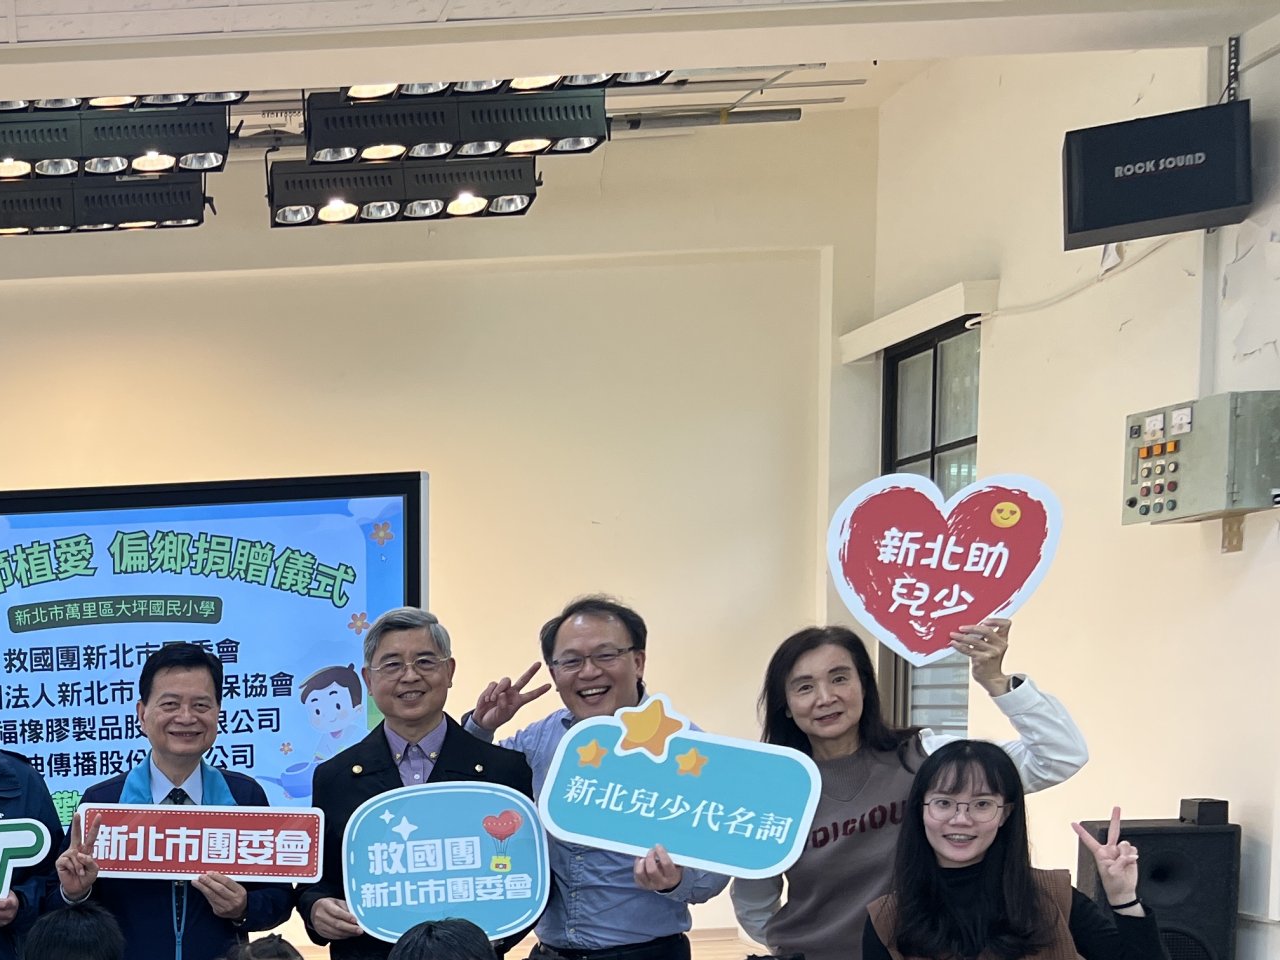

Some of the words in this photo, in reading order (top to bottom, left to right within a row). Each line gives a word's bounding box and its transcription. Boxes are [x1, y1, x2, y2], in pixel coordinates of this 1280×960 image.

[1114, 159, 1156, 178] ROCK
[1158, 152, 1207, 170] SOUND
[107, 530, 357, 608] 偏鄉捐贈儀式
[877, 527, 1009, 578] 新北助
[14, 598, 216, 627] 新北市萬里區大坪國民小學
[888, 574, 975, 618] 兒少
[562, 775, 794, 845] 新北兒少代名詞
[92, 824, 312, 867] 新北市團委會
[367, 836, 482, 876] 救國團
[360, 873, 533, 909] 新北市團委會
